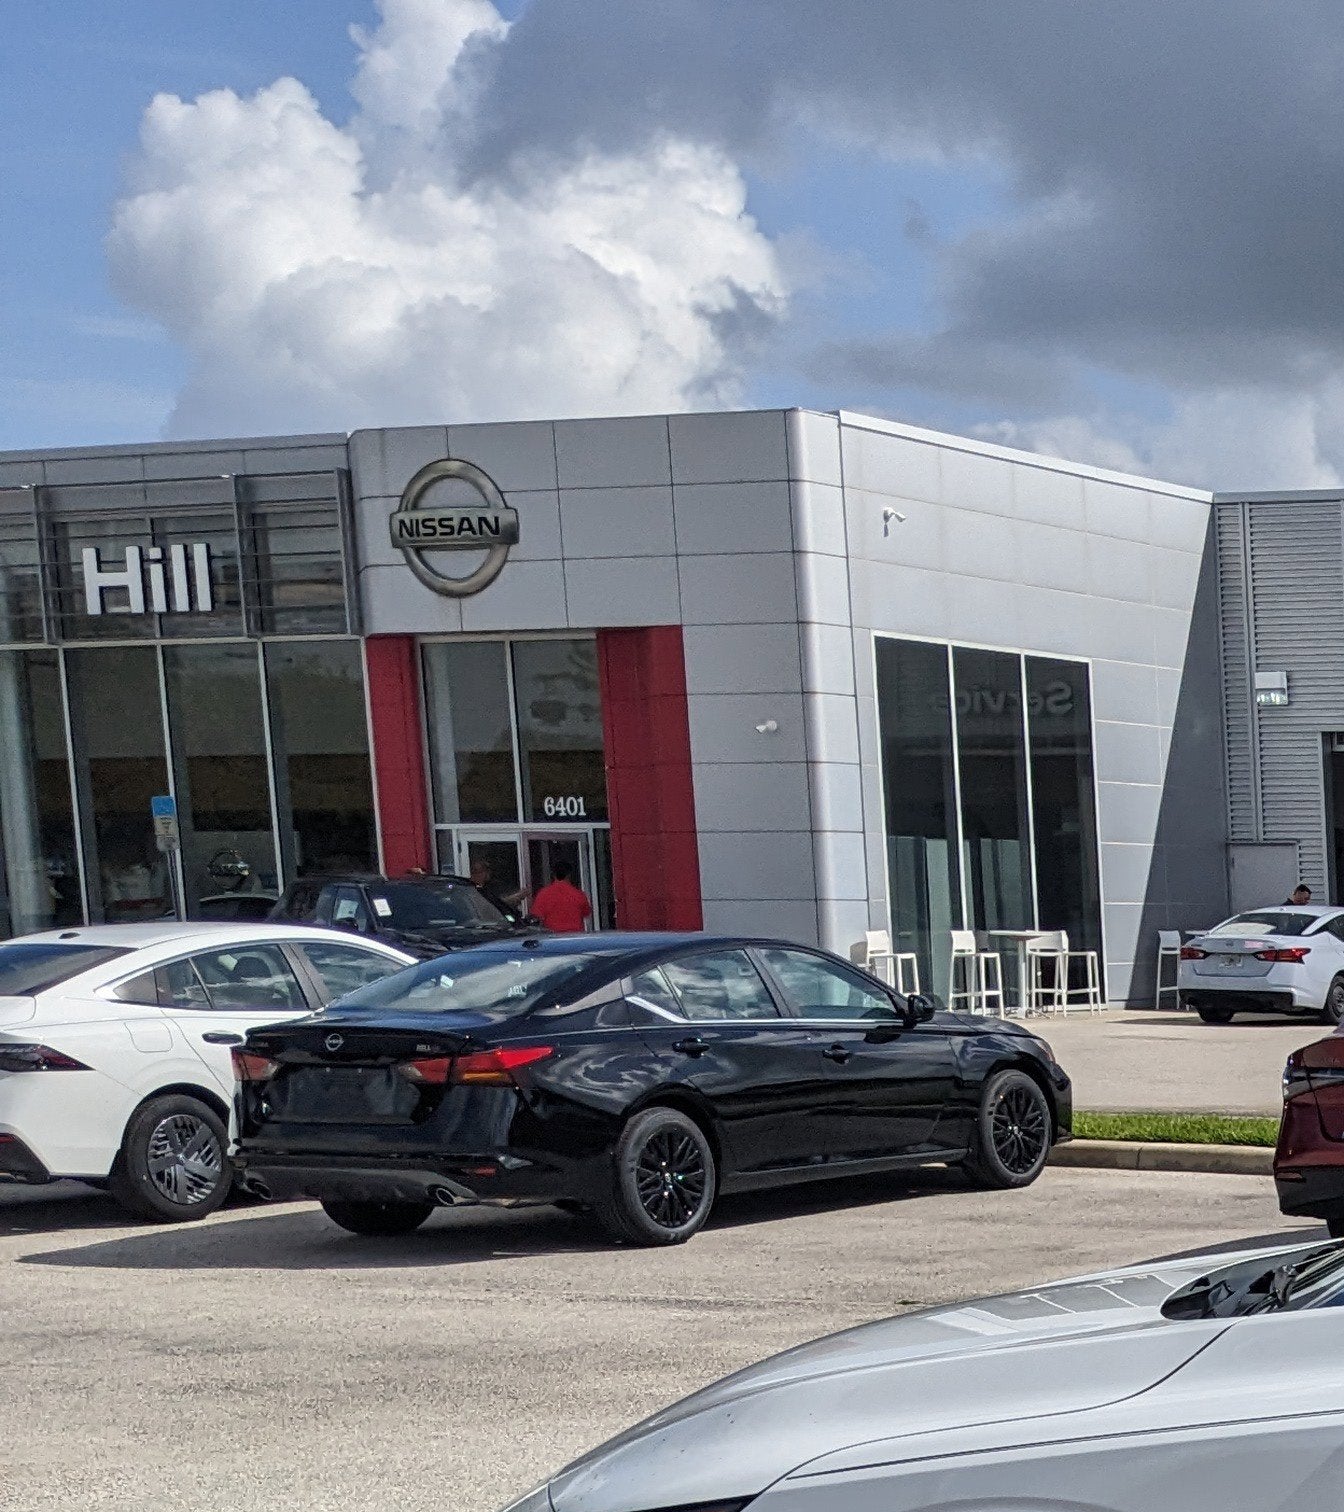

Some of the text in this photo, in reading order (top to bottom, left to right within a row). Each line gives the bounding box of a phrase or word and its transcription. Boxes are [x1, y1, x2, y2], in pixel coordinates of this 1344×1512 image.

[398, 516, 502, 540] NISSAN
[83, 543, 214, 615] Hill
[543, 796, 586, 818] 6401
